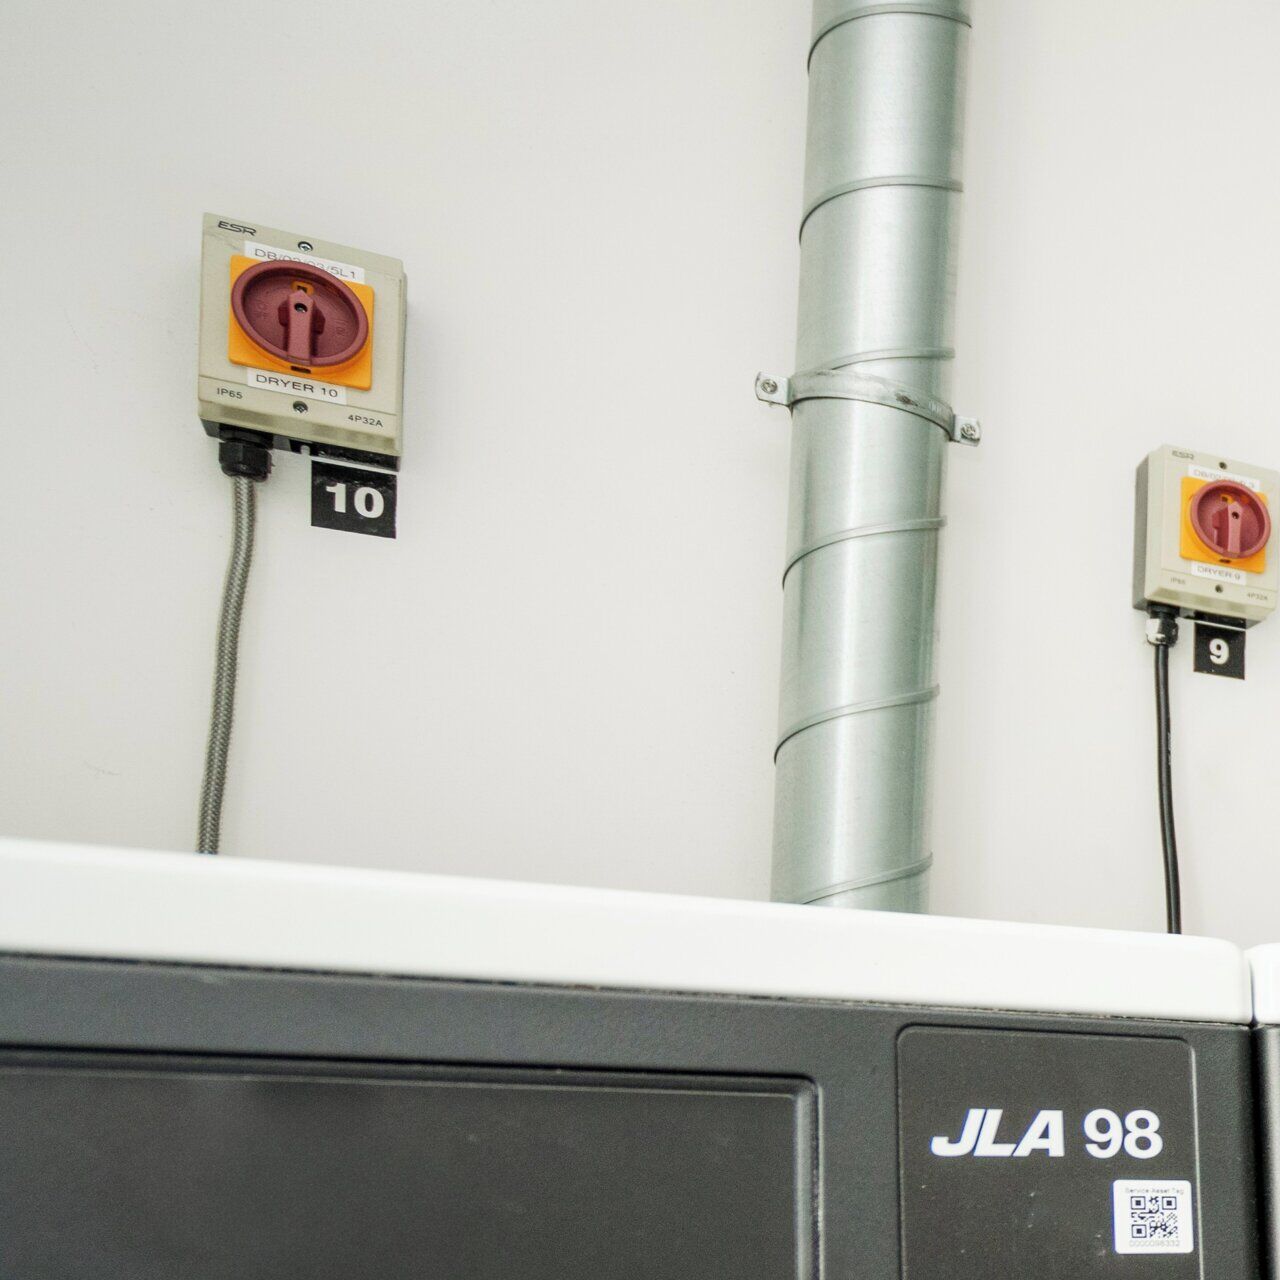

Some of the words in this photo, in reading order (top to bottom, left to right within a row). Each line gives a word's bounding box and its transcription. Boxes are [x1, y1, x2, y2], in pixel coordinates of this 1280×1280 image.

[218, 221, 257, 236] ESR
[217, 387, 243, 399] IP65
[256, 374, 314, 393] DRYER
[321, 387, 338, 398] 10
[348, 414, 383, 428] 4P32A
[325, 482, 385, 519] 10
[1209, 638, 1230, 665] 9
[931, 1108, 1065, 1157] JLA
[1083, 1108, 1163, 1159] 98
